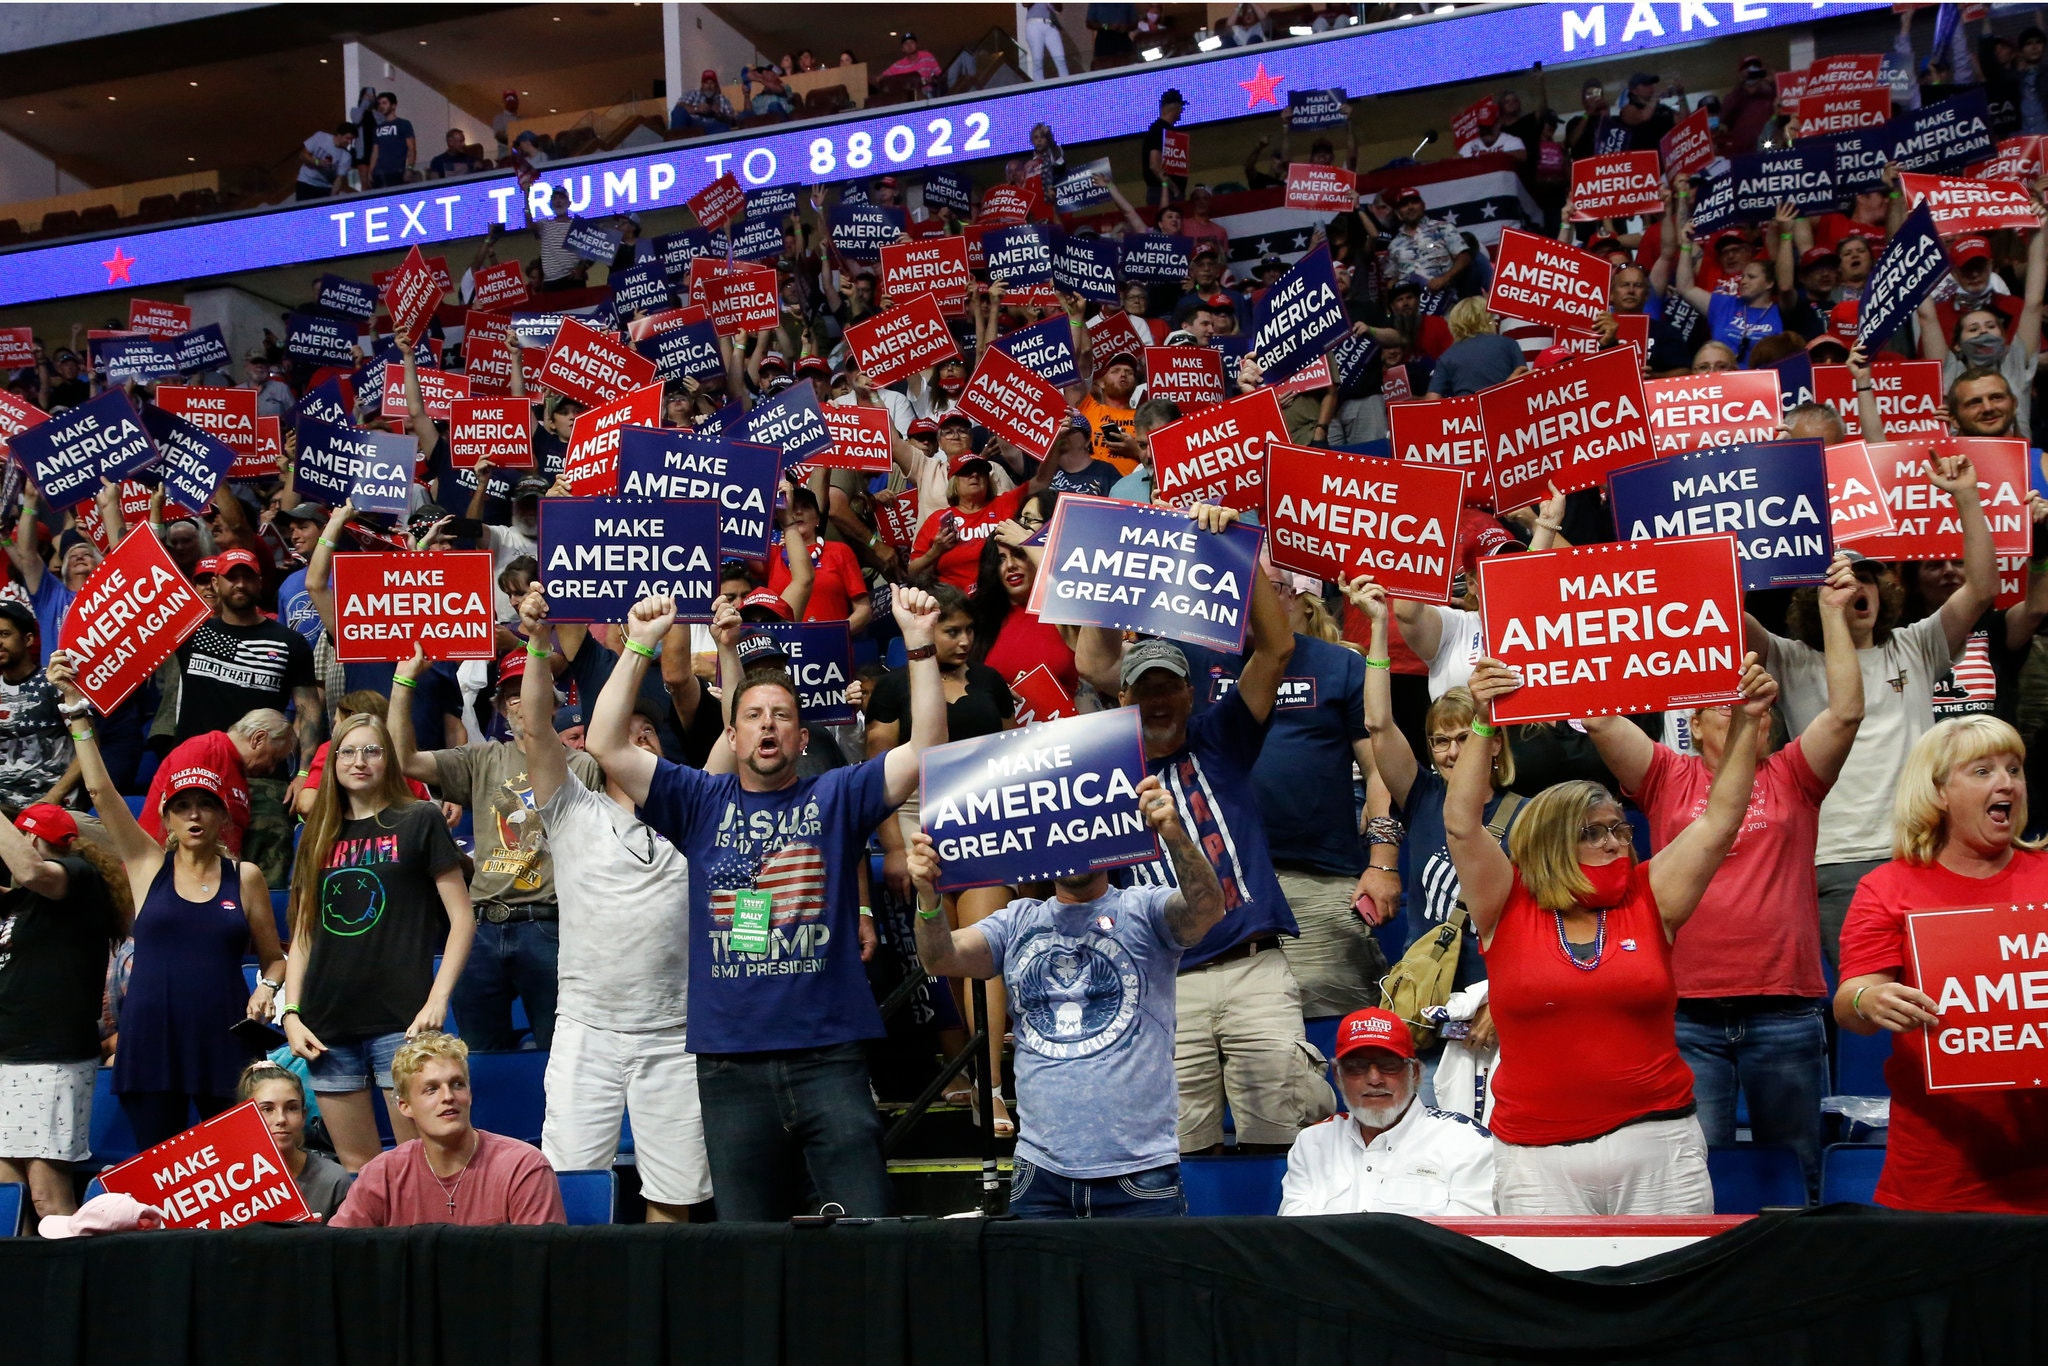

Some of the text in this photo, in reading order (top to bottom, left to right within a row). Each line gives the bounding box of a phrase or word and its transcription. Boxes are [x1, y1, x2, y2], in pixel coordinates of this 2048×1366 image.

[376, 125, 397, 136] USA
[1915, 110, 1954, 131] MAKE
[1894, 117, 1985, 157] AMERICA
[1896, 134, 1988, 171] GREAT AGAIN
[1596, 163, 1631, 175] MAKE
[1762, 159, 1802, 172] MAKE
[331, 112, 991, 247] TEXT TRUMP TO 88022
[1290, 180, 1350, 192] AMERICA
[1574, 173, 1656, 196] AMERICA
[1738, 171, 1830, 194] AMERICA
[1575, 190, 1657, 208] GREAT AGAIN
[1739, 190, 1830, 208] GREAT AGAIN
[1913, 189, 2030, 205] AMERICA
[1977, 205, 2032, 217] AGAIN
[907, 250, 939, 262] MAKE
[1126, 252, 1188, 265] AMERICA
[1145, 242, 1171, 250] MAKE
[888, 259, 964, 281] AMERICA
[1158, 267, 1187, 275] AGAIN
[1536, 252, 1579, 273] MAKE
[889, 276, 966, 293] GREAT AGAIN
[1501, 262, 1603, 302] AMERICA
[1269, 278, 1304, 312] MAKE
[1498, 284, 1602, 320] GREAT AGAIN
[310, 324, 337, 334] MAKE
[875, 315, 911, 337] MAKE
[1255, 283, 1335, 352] AMERICA
[290, 332, 352, 350] AMERICA
[863, 319, 942, 364] AMERICA
[1257, 305, 1341, 371] GREAT AGAIN
[109, 354, 173, 366] AMERICA
[290, 345, 352, 360] GREAT AGAIN
[867, 334, 948, 377] GREAT AGAIN
[770, 375, 793, 386] TRUMP
[1006, 373, 1042, 401] MAKE
[187, 398, 224, 409] MAKE
[974, 375, 1053, 433] AMERICA
[1527, 380, 1588, 415] MAKE
[1656, 386, 1723, 403] MAKE
[473, 410, 502, 420] MAKE
[748, 404, 787, 431] MAKE
[823, 413, 859, 425] MAKE
[968, 390, 1048, 446] GREAT AGAIN
[1497, 394, 1638, 460] AMERICA
[51, 416, 98, 446] MAKE
[454, 423, 525, 438] AMERICA
[782, 425, 824, 455] AGAIN
[1186, 419, 1239, 452] MAKE
[1698, 427, 1774, 448] AGAIN
[37, 419, 139, 481] AMERICA
[330, 439, 376, 456] MAKE
[454, 444, 526, 454] GREAT AGAIN
[850, 445, 888, 458] AGAIN
[1500, 427, 1644, 485] GREAT AGAIN
[46, 437, 148, 494] GREAT AGAIN
[301, 450, 406, 484] AMERICA
[665, 452, 726, 475] MAKE
[300, 469, 405, 500] GREAT AGAIN
[623, 470, 765, 514] AMERICA
[1323, 476, 1397, 503] MAKE
[1672, 468, 1759, 501] MAKE
[595, 519, 663, 536] MAKE
[1276, 498, 1445, 549] AMERICA
[1630, 494, 1820, 541] AMERICA
[1121, 525, 1195, 553] MAKE
[1487, 536, 1507, 546] 2020
[1737, 535, 1824, 560] AGAIN
[548, 545, 710, 570] AMERICA
[1275, 531, 1443, 577] GREAT AGAIN
[384, 571, 443, 585] MAKE
[1063, 545, 1239, 596] AMERICA
[76, 570, 125, 621] MAKE
[549, 580, 710, 598] GREAT AGAIN
[1561, 571, 1657, 601] MAKE
[345, 593, 484, 615] AMERICA
[1058, 578, 1237, 623] GREAT AGAIN
[68, 566, 173, 673] AMERICA
[345, 622, 485, 639] GREAT AGAIN
[1501, 600, 1727, 652] AMERICA
[84, 586, 189, 690] GREAT AGAIN
[736, 636, 772, 654] TRUMP
[188, 658, 281, 688] BUILD THAT WALL
[1624, 646, 1731, 677] AGAIN
[1943, 704, 1963, 712] THE
[1676, 718, 1690, 750] AND
[987, 744, 1073, 779] MAKE
[171, 767, 222, 785] MAKE AMERICA
[174, 776, 197, 789] GREAT
[934, 768, 1139, 829] AMERICA
[715, 832, 730, 847] IS
[762, 821, 822, 853] SAOR
[939, 810, 1144, 861] GREAT AGAIN
[1747, 821, 1768, 832] you
[740, 912, 763, 920] RALLY
[712, 958, 827, 978] IS MY PRESIDENT
[1350, 1019, 1392, 1031] Trump
[152, 1145, 220, 1190] MAKE
[151, 1153, 279, 1225] MERICA
[220, 1182, 291, 1229] AGAIN
